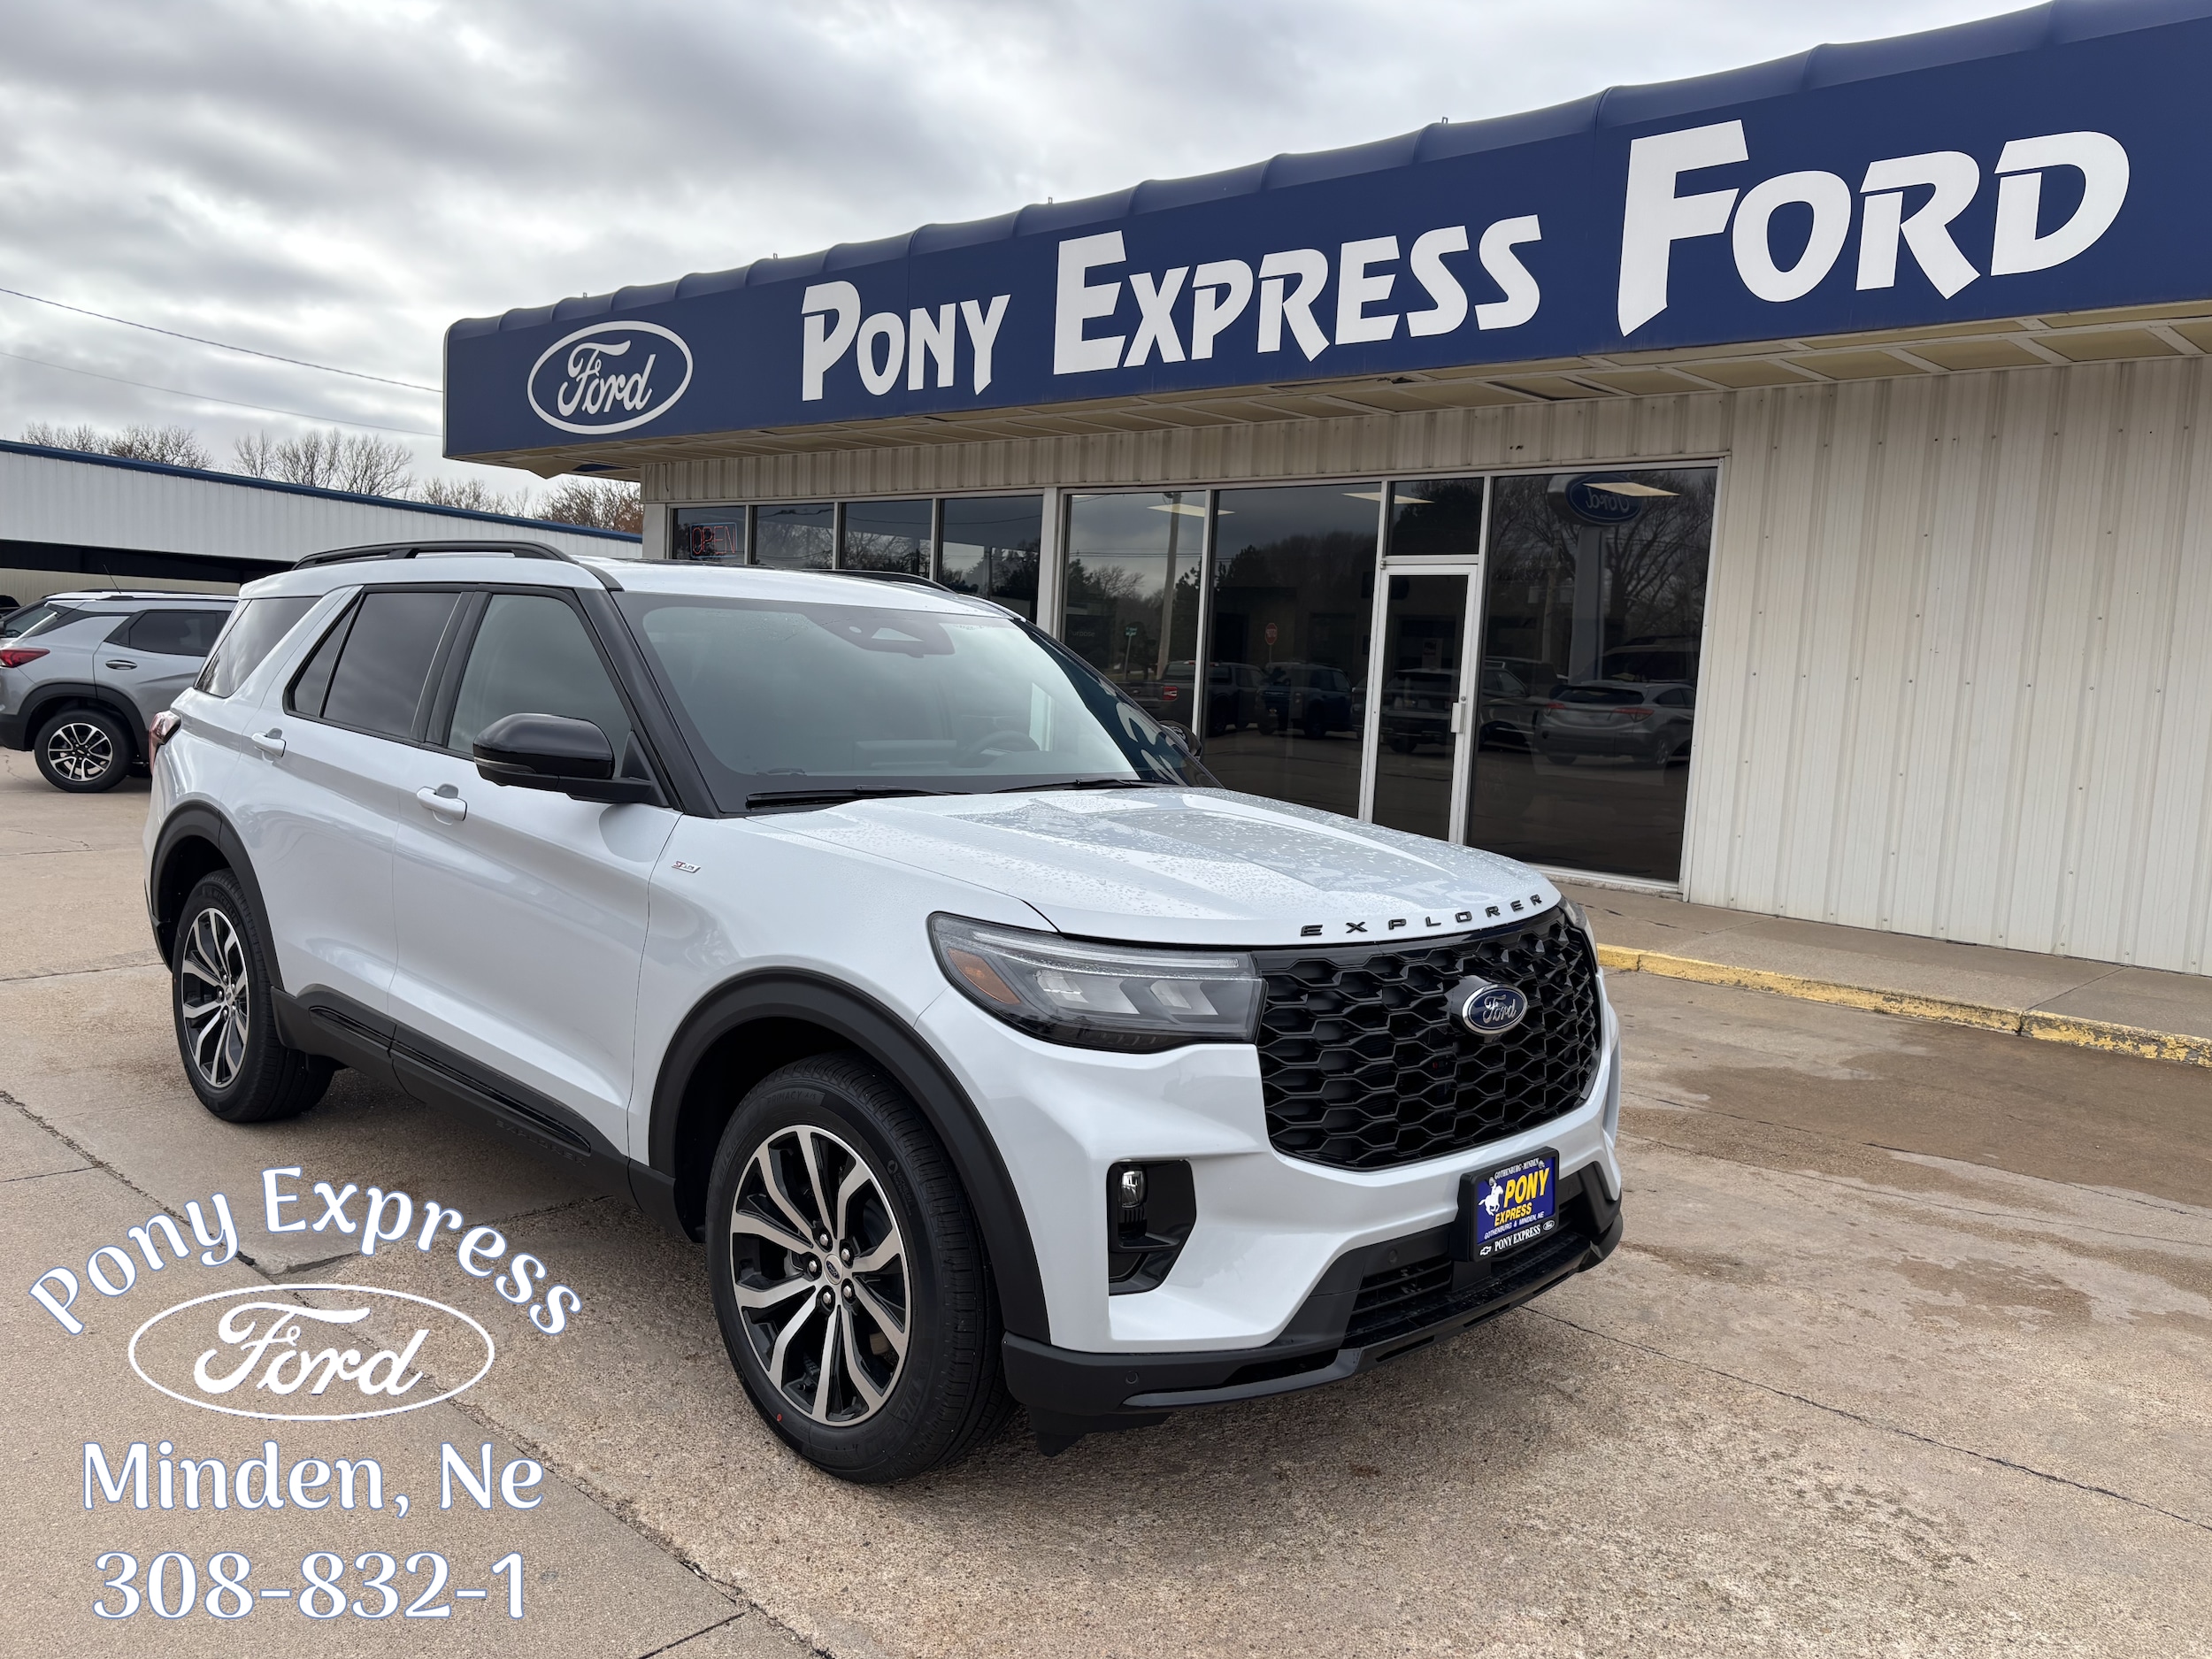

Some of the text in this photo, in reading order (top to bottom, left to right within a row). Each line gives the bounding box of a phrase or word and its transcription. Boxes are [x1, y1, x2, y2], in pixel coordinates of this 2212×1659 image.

[802, 119, 2131, 402] PONY EXPRESS FORD
[557, 340, 657, 417] Ford
[692, 526, 736, 555] OPEN
[1300, 894, 1543, 937] EXPLORER
[1482, 995, 1517, 1024] Ford
[766, 1090, 803, 1105] PRIMACY
[1503, 1167, 1550, 1209] PONY
[1484, 1222, 1512, 1240] GOTHENBURG
[1537, 1210, 1545, 1219] NE
[1494, 1202, 1532, 1227] EXPRESS
[1494, 1224, 1541, 1252] PONY EXPRESS
